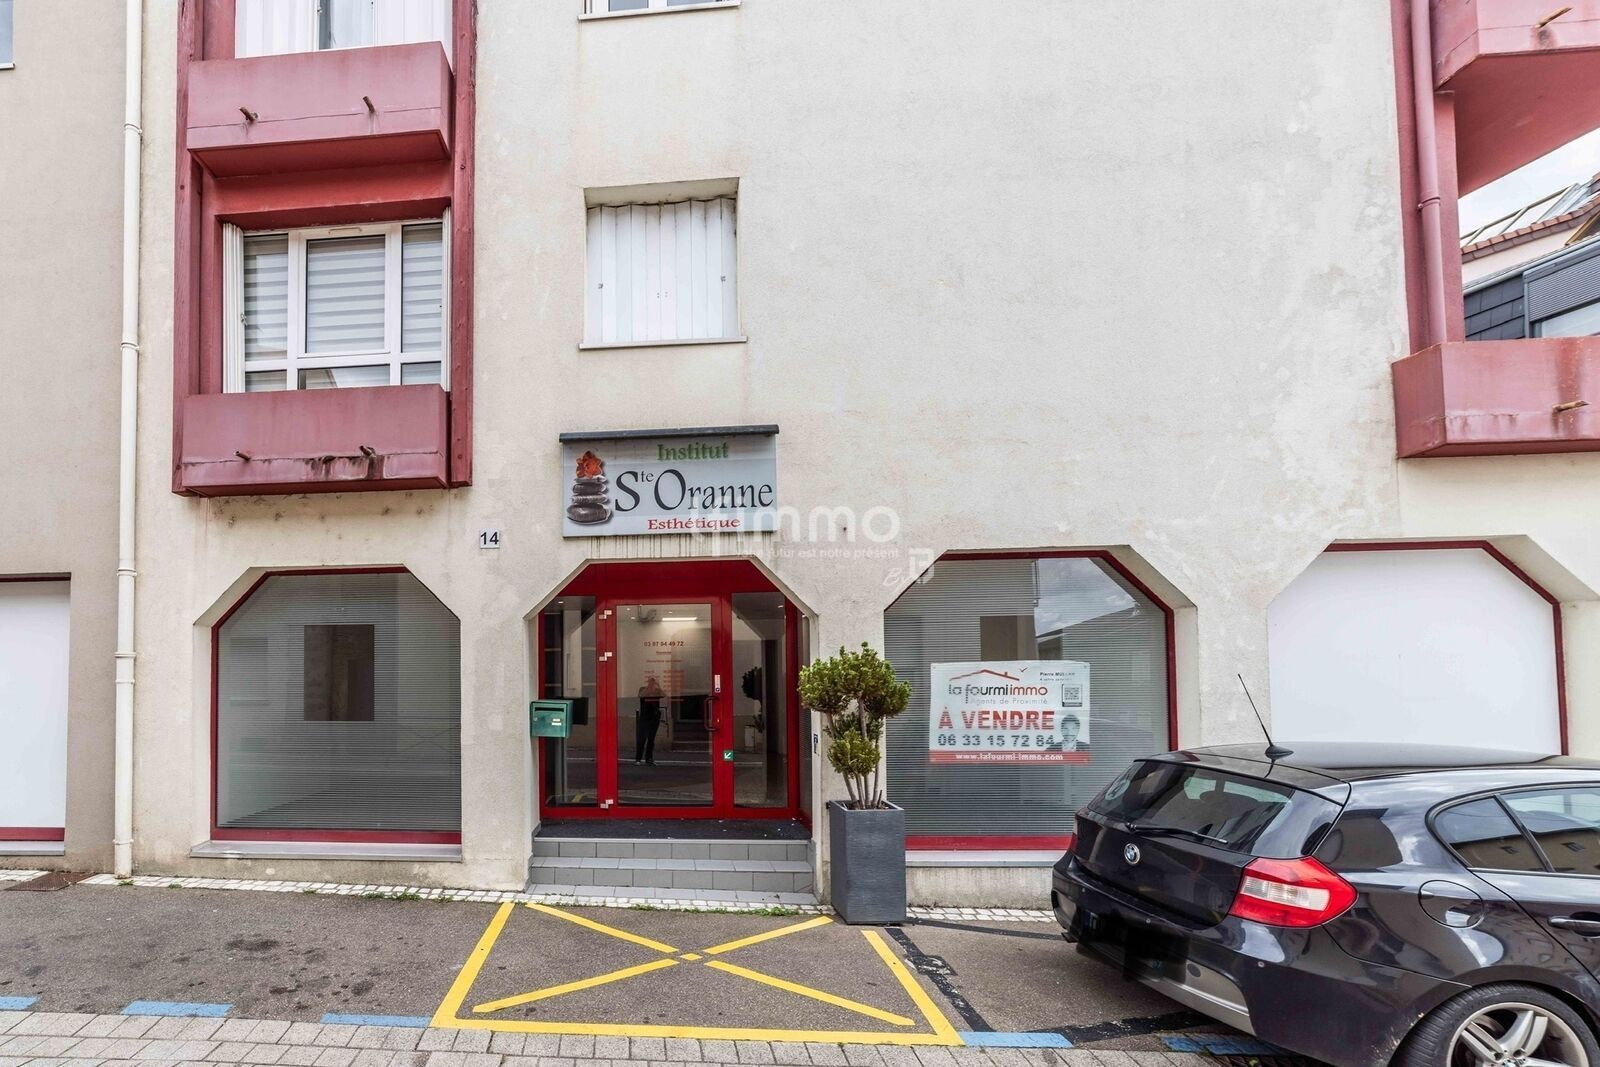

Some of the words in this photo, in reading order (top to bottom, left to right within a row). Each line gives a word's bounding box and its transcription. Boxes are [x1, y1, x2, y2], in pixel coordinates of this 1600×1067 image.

[656, 441, 729, 461] Institut
[615, 470, 654, 512] Ste
[654, 468, 774, 511] Oranne
[647, 517, 741, 531] Esthétique
[480, 531, 499, 545] 14
[999, 696, 1009, 705] de
[1012, 696, 1048, 705] Proximité
[938, 706, 953, 729] À
[961, 710, 1055, 731] VENDRE
[937, 733, 956, 746] 06
[962, 734, 981, 746] 33
[986, 735, 1005, 747] 15
[1011, 735, 1030, 747] 72
[1035, 734, 1055, 747] 84
